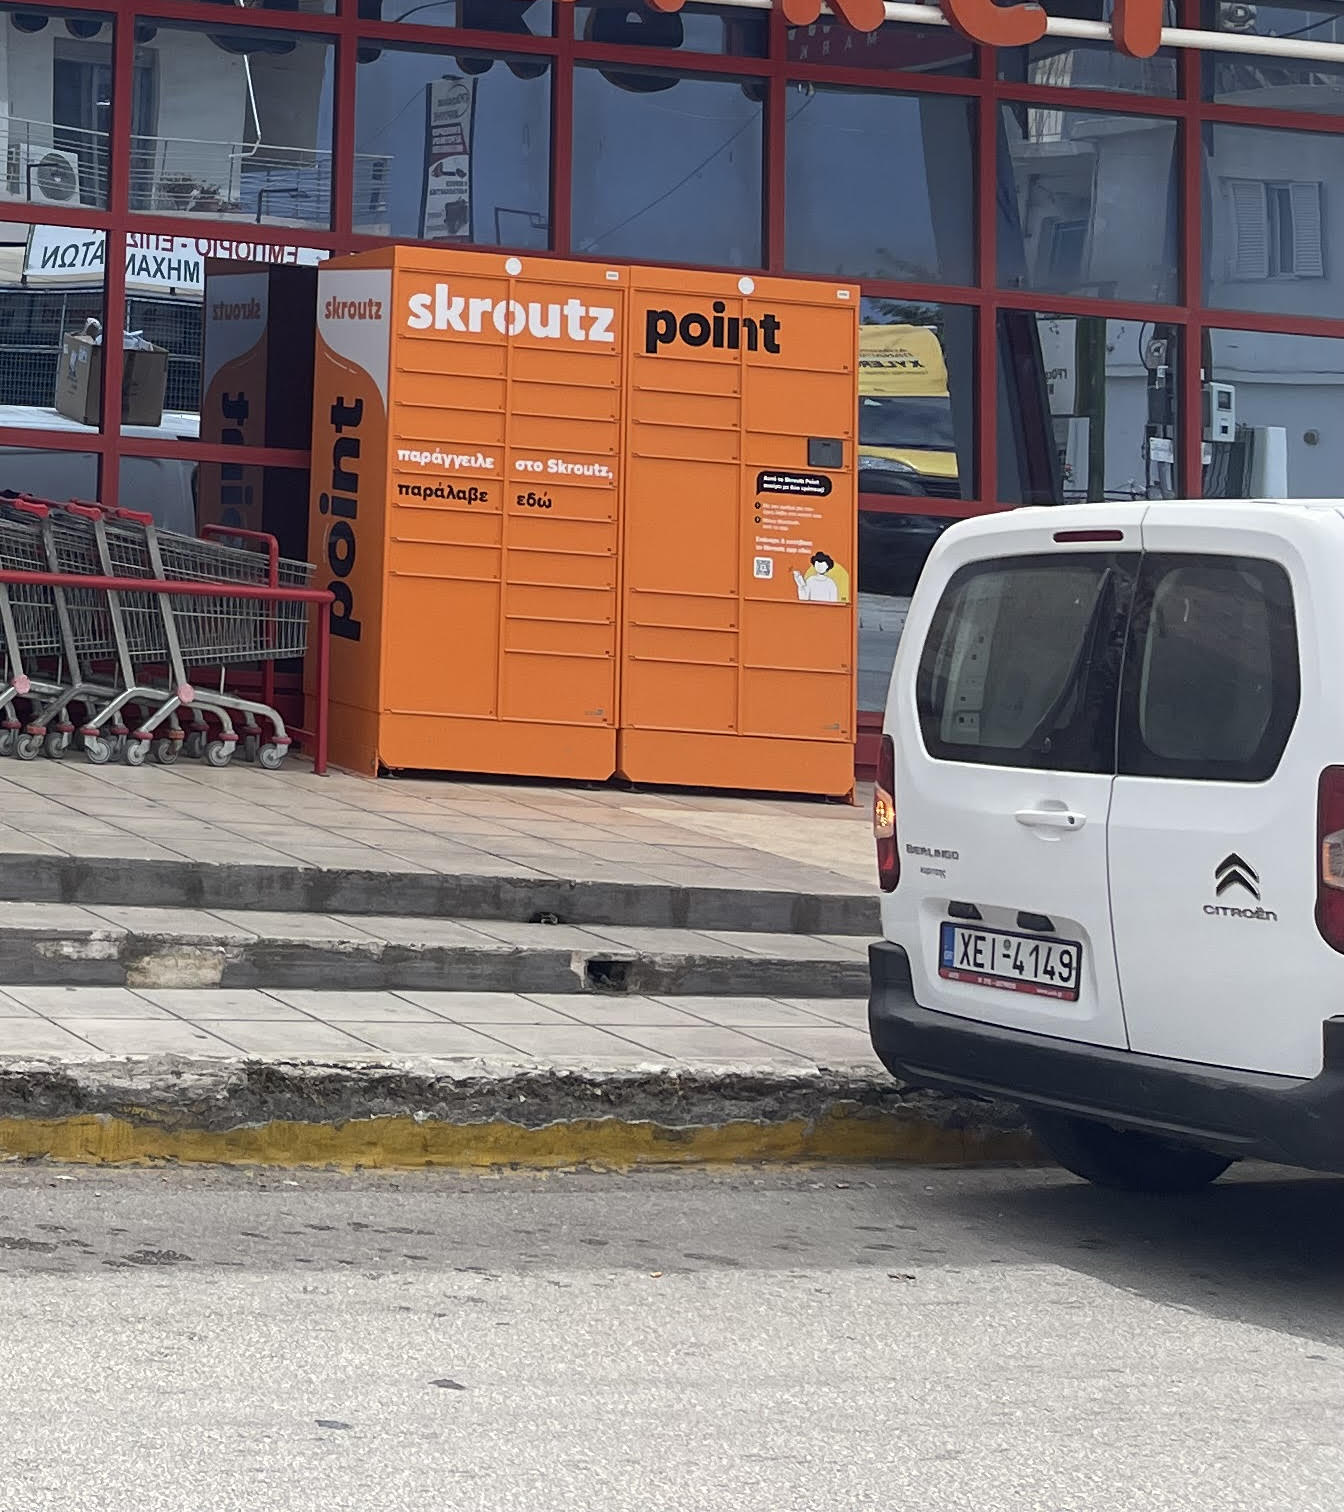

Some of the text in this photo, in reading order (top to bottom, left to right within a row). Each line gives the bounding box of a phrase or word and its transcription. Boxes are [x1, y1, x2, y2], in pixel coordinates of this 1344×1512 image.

[325, 296, 382, 320] skroutz
[407, 283, 781, 355] skroutz point
[397, 448, 614, 479] παράγγειλε στο Skroutz,
[398, 481, 552, 509] παράλαβε εδώ
[320, 396, 363, 641] point
[906, 843, 959, 860] BERLINGO
[959, 932, 1073, 983] XEI-4149
